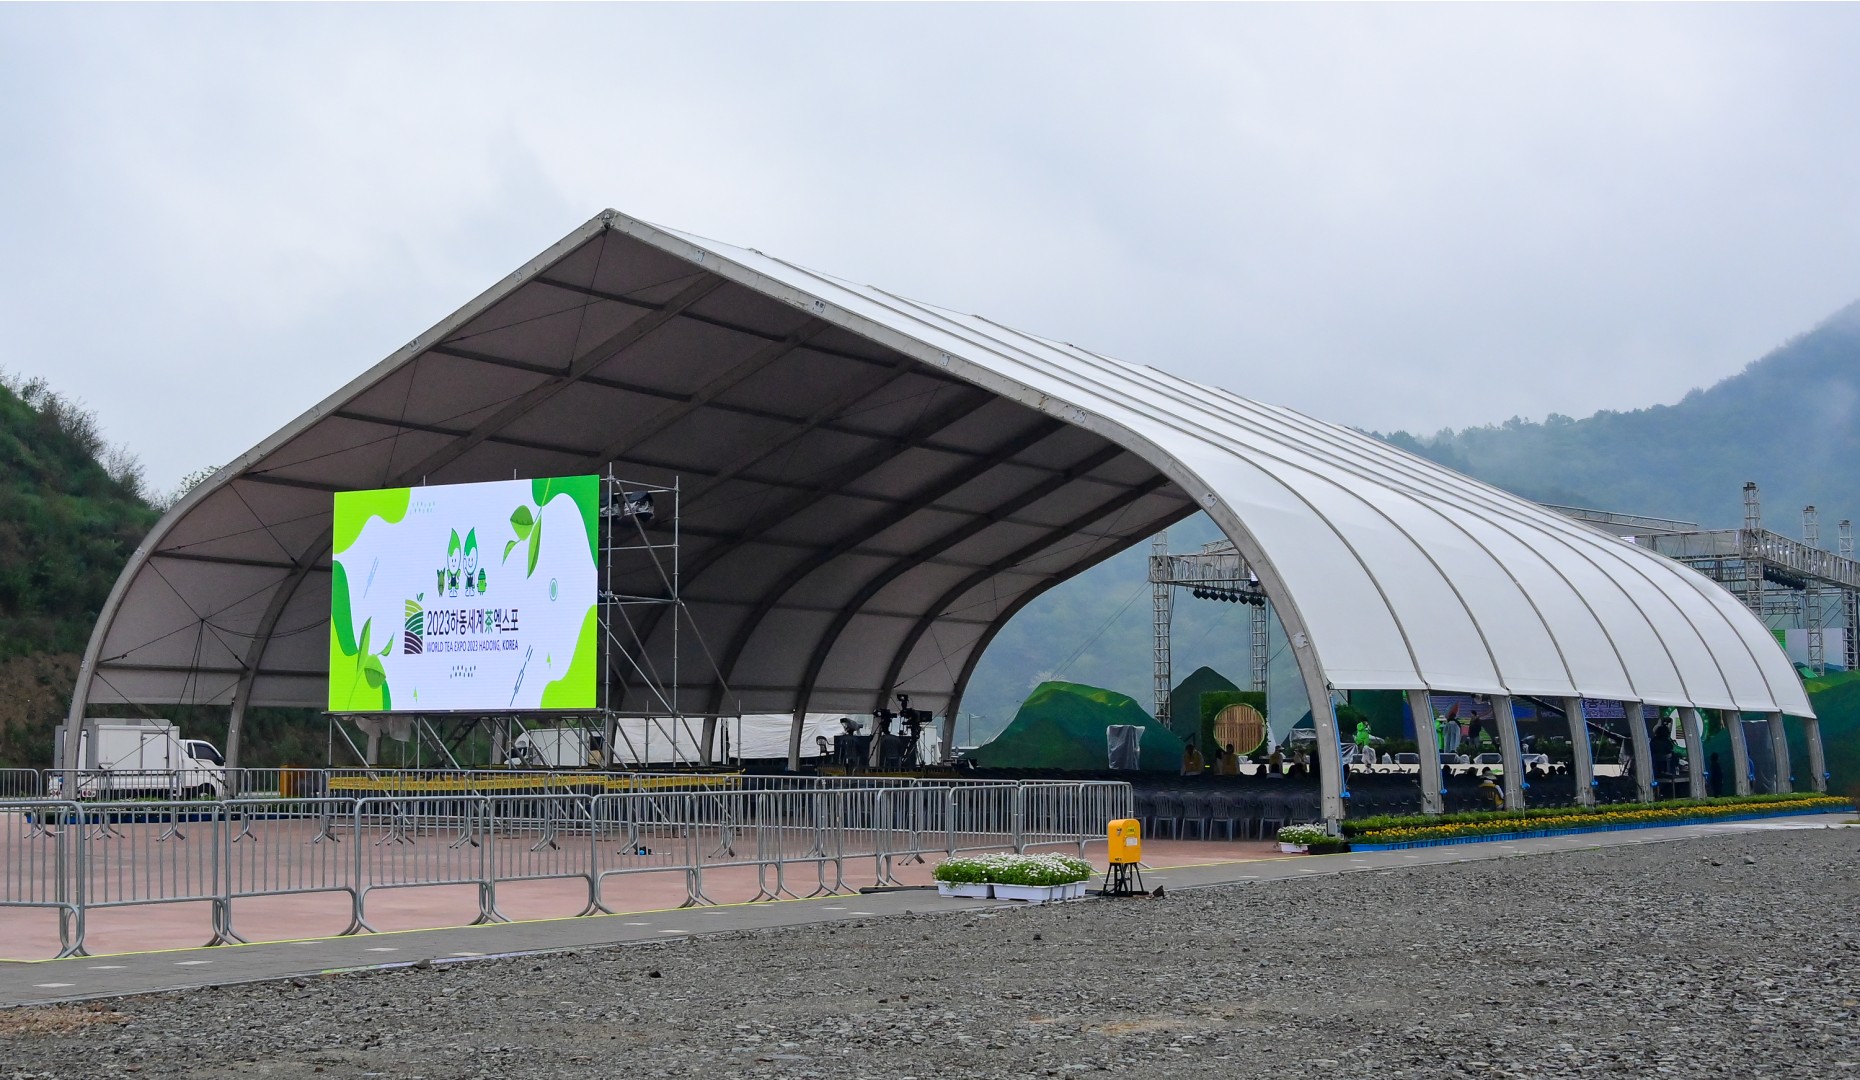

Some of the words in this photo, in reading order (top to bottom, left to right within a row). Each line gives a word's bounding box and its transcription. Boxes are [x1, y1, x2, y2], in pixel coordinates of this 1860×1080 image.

[427, 609, 519, 636] 2023하동세계茶엑스포
[427, 642, 444, 652] WORLD
[444, 641, 453, 652] TEA
[454, 641, 467, 652] EXPO
[467, 640, 478, 652] 2023
[479, 640, 501, 652] HADONG,
[502, 639, 519, 651] KOREA
